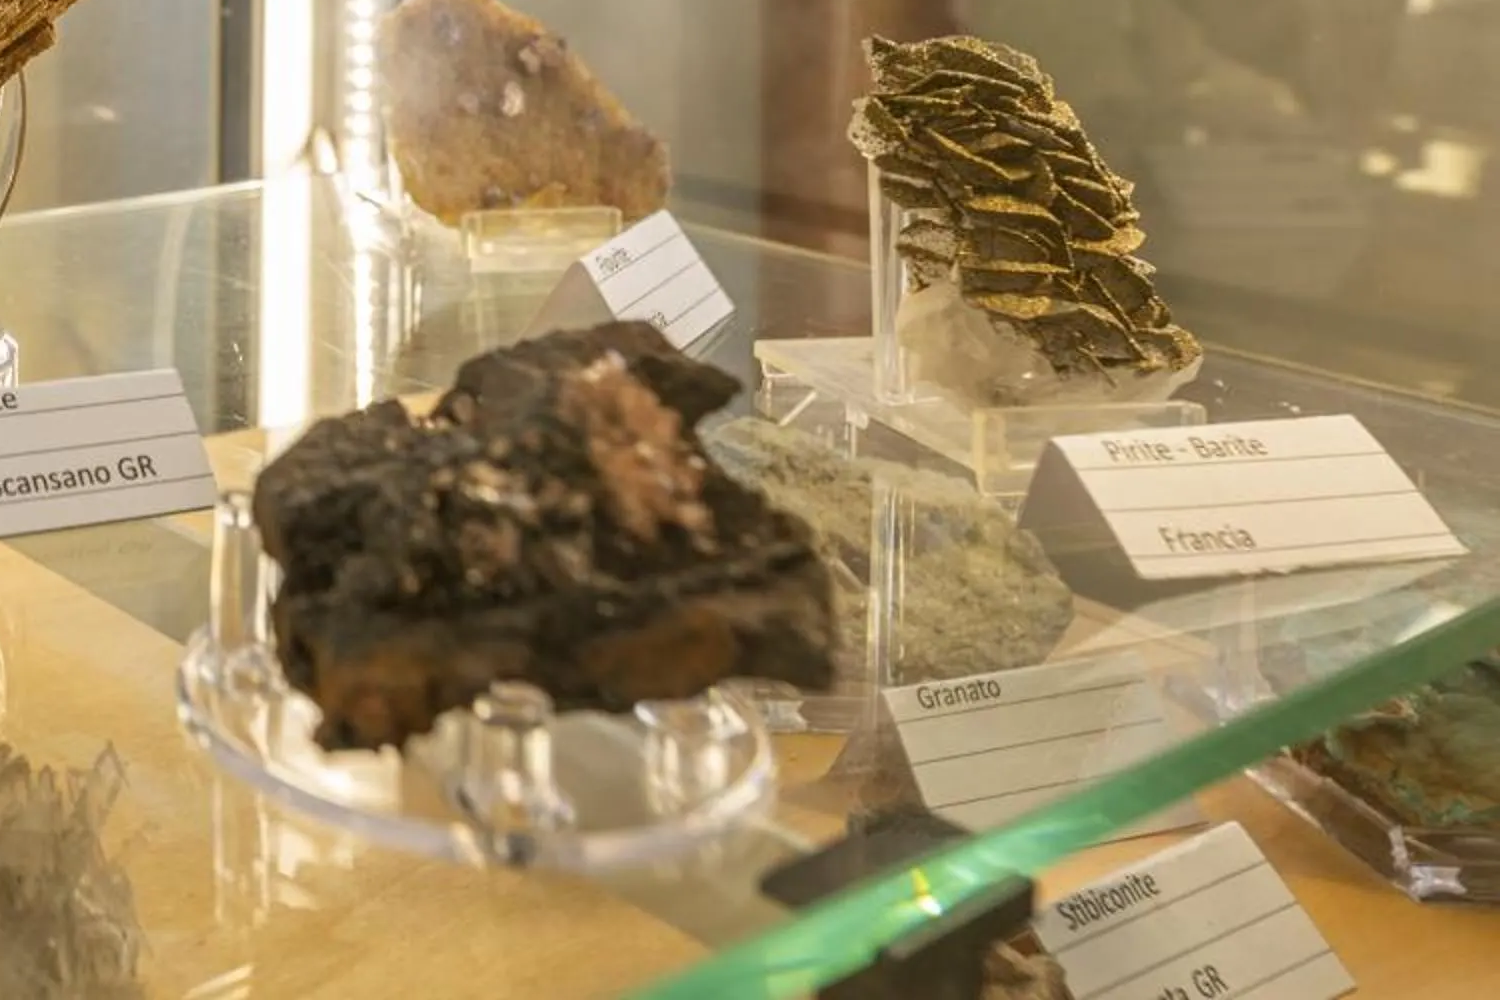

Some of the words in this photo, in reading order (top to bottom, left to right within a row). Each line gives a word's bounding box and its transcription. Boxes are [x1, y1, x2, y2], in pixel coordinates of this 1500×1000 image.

[1101, 439, 1175, 462] Pirite
[1187, 434, 1269, 460] Barite
[117, 454, 157, 482] GR
[1157, 523, 1258, 552] Francia
[916, 678, 1002, 710] Granato
[1055, 872, 1162, 931] Stibiconite
[1191, 963, 1230, 999] GR
